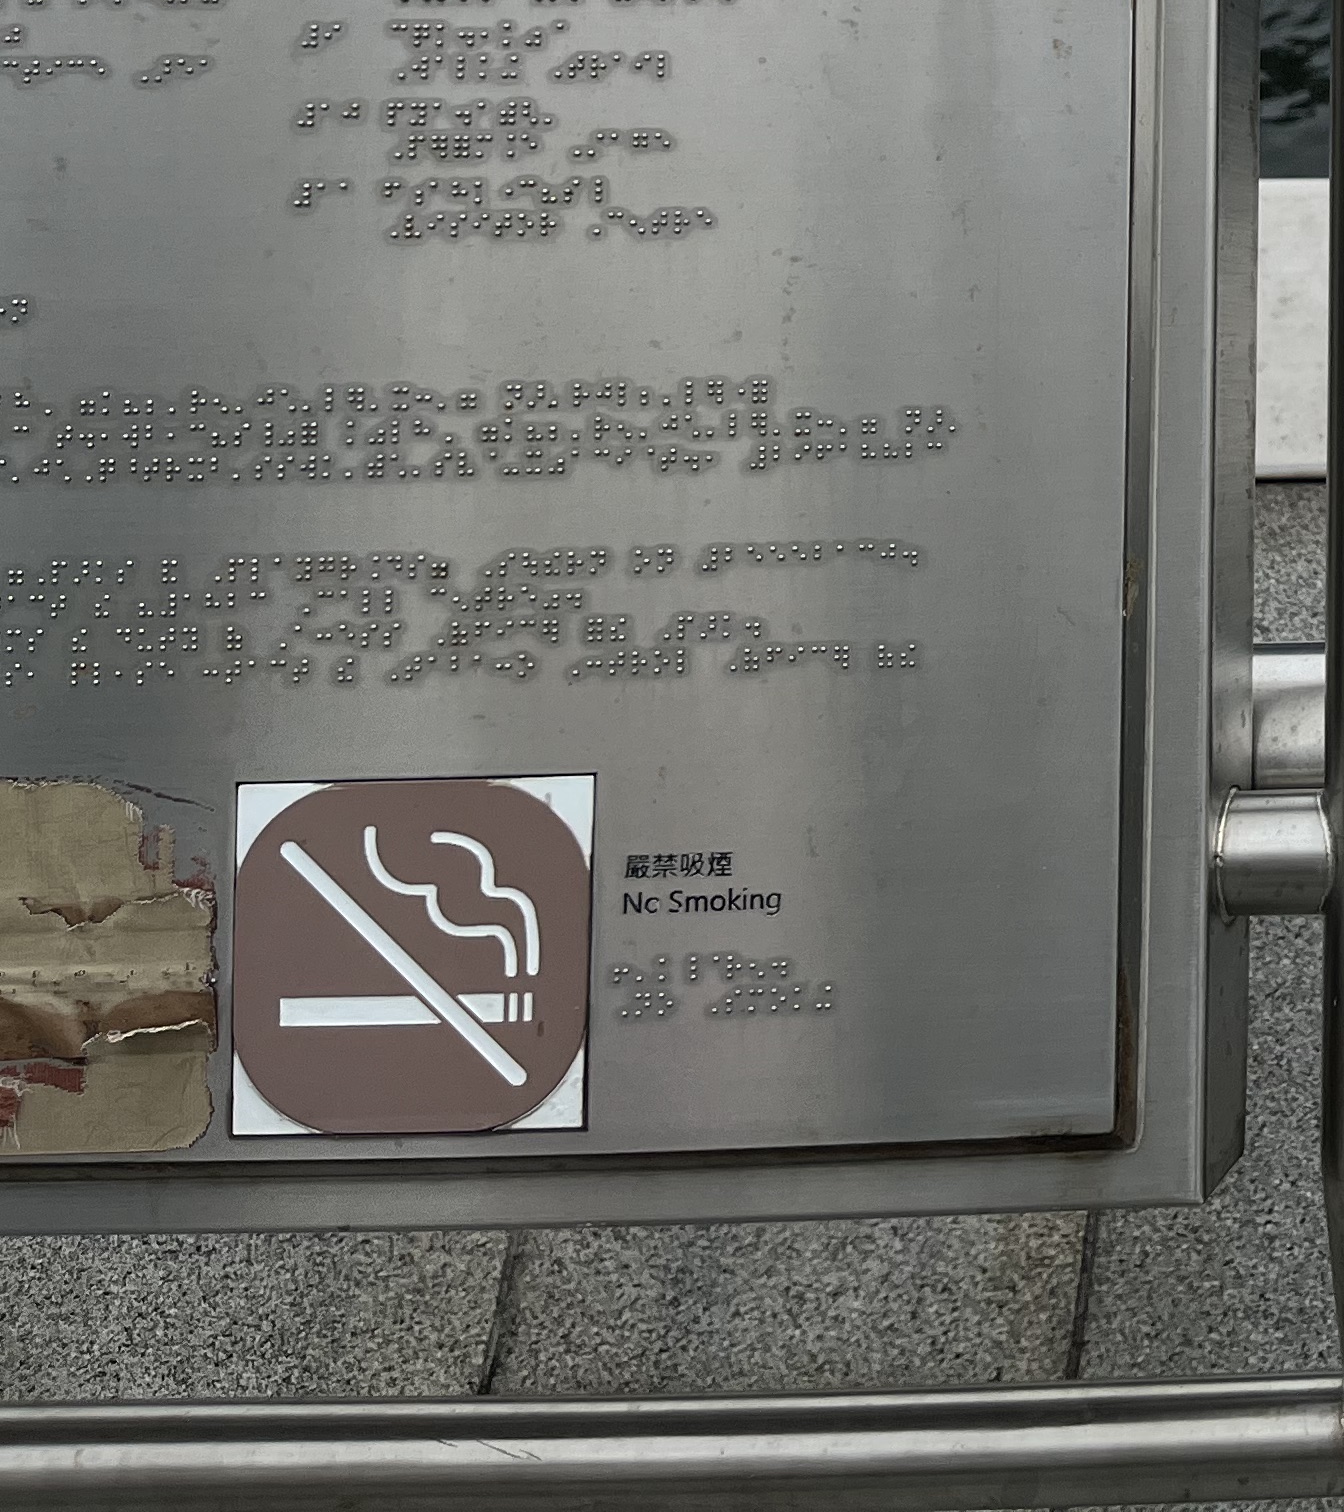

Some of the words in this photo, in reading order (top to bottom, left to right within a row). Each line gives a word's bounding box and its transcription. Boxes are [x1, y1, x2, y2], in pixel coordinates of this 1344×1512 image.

[623, 850, 735, 880] 嚴禁吸煙
[667, 887, 783, 917] Smoking
